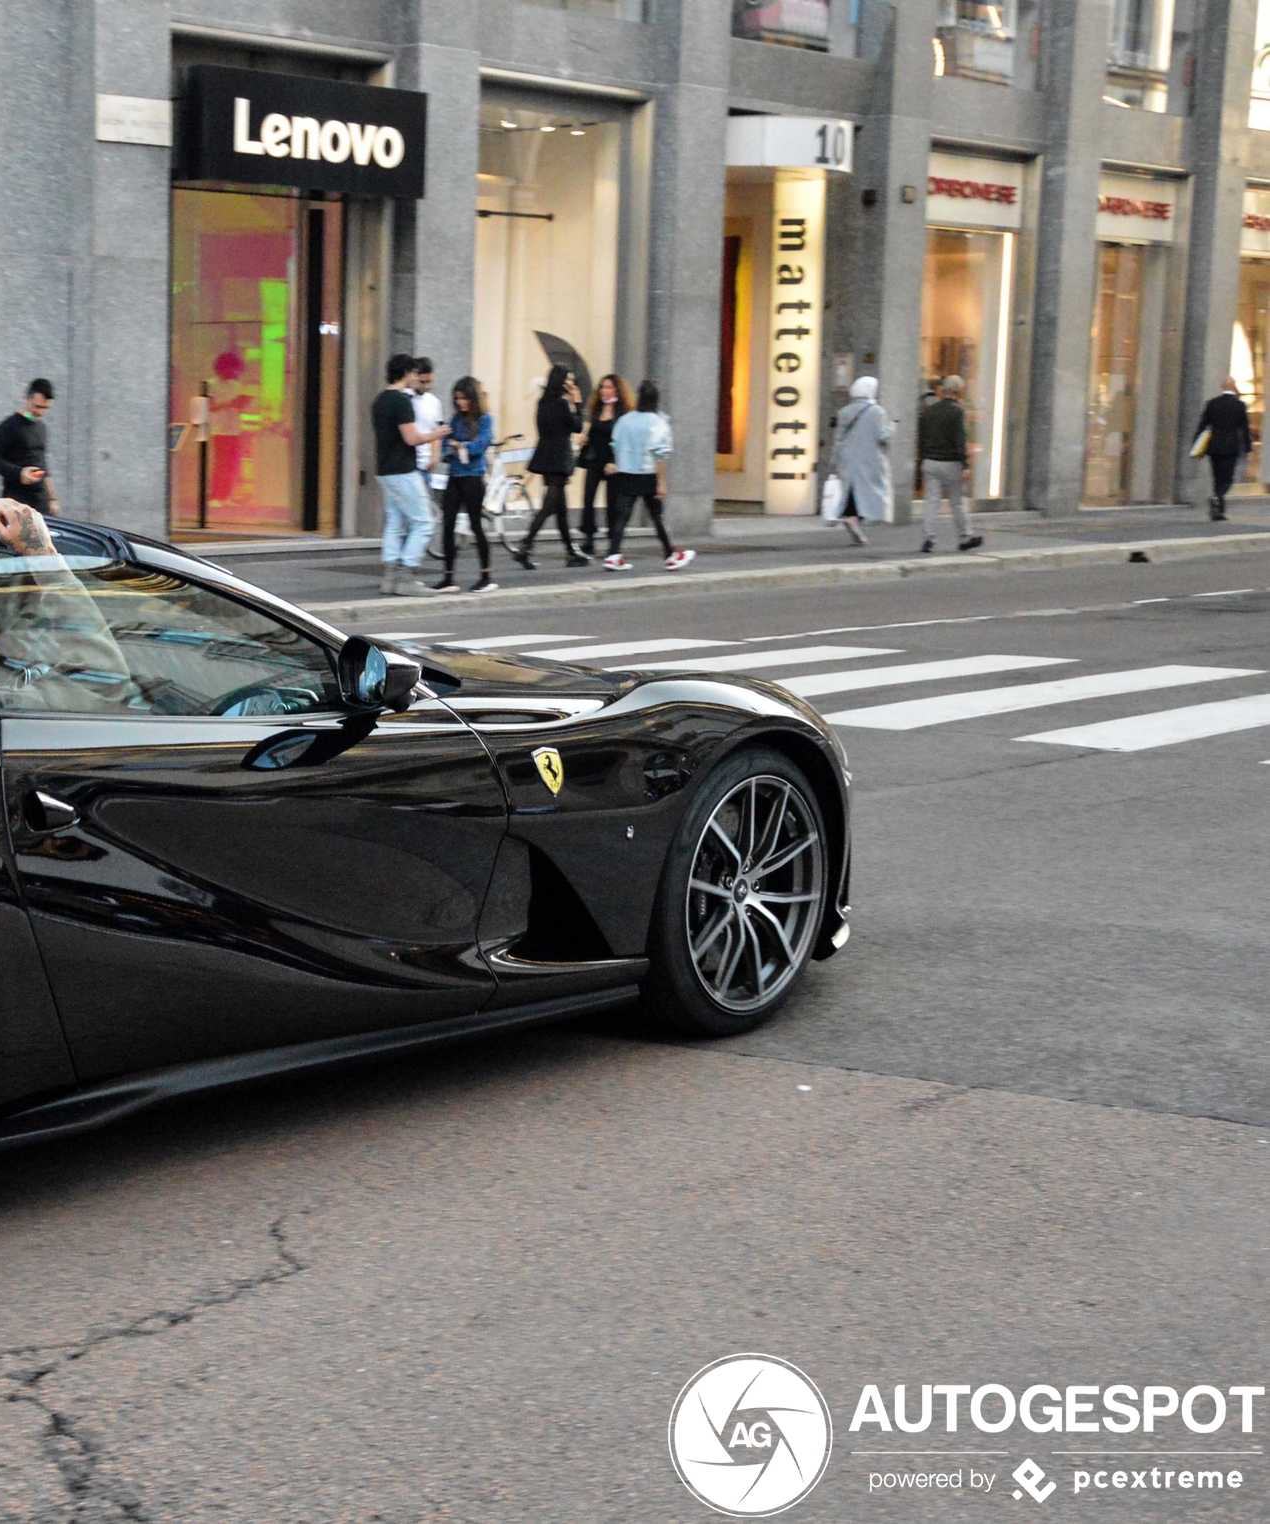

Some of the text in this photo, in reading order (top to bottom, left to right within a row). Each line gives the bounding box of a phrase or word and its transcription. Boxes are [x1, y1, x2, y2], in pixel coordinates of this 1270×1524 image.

[233, 97, 405, 170] Lenovo
[814, 123, 847, 166] 10
[927, 176, 1018, 204] ORBONESE
[771, 217, 812, 482] matteotti
